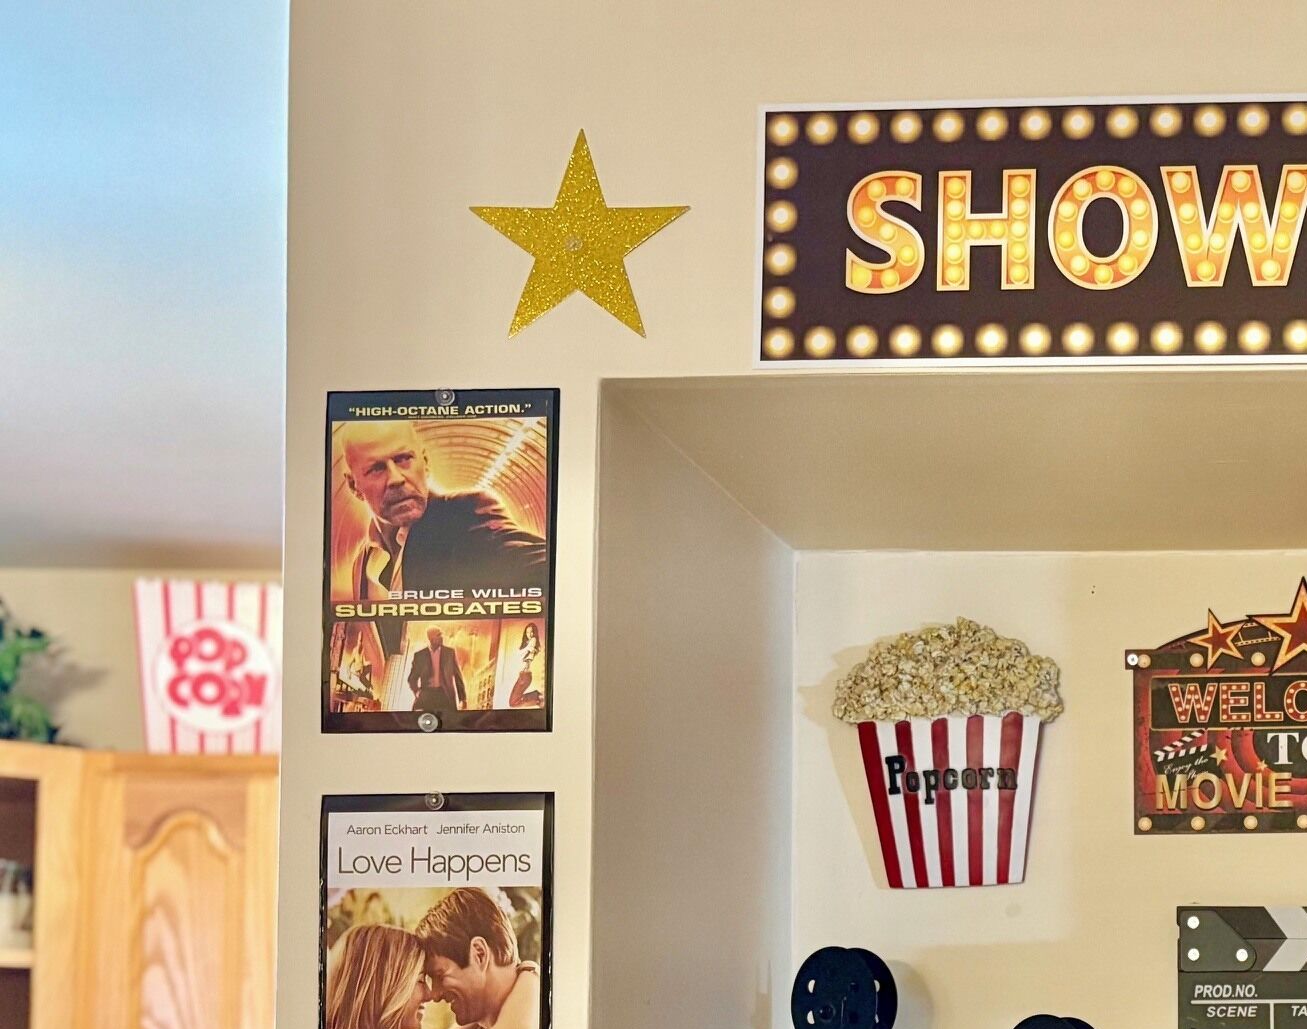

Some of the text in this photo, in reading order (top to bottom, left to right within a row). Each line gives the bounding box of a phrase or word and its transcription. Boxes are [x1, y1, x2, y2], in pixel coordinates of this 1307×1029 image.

[388, 588, 542, 600] BRUCE WILLIS
[335, 601, 542, 618] SURROGATES
[885, 755, 1018, 804] Popcorn
[1155, 773, 1293, 811] MOVIE
[347, 823, 525, 834] Aaron Eckhart Jennifer Aniston
[338, 846, 531, 881] Love Happens
[1194, 984, 1258, 998] PROD.NO.
[1206, 1006, 1257, 1018] SCENE
